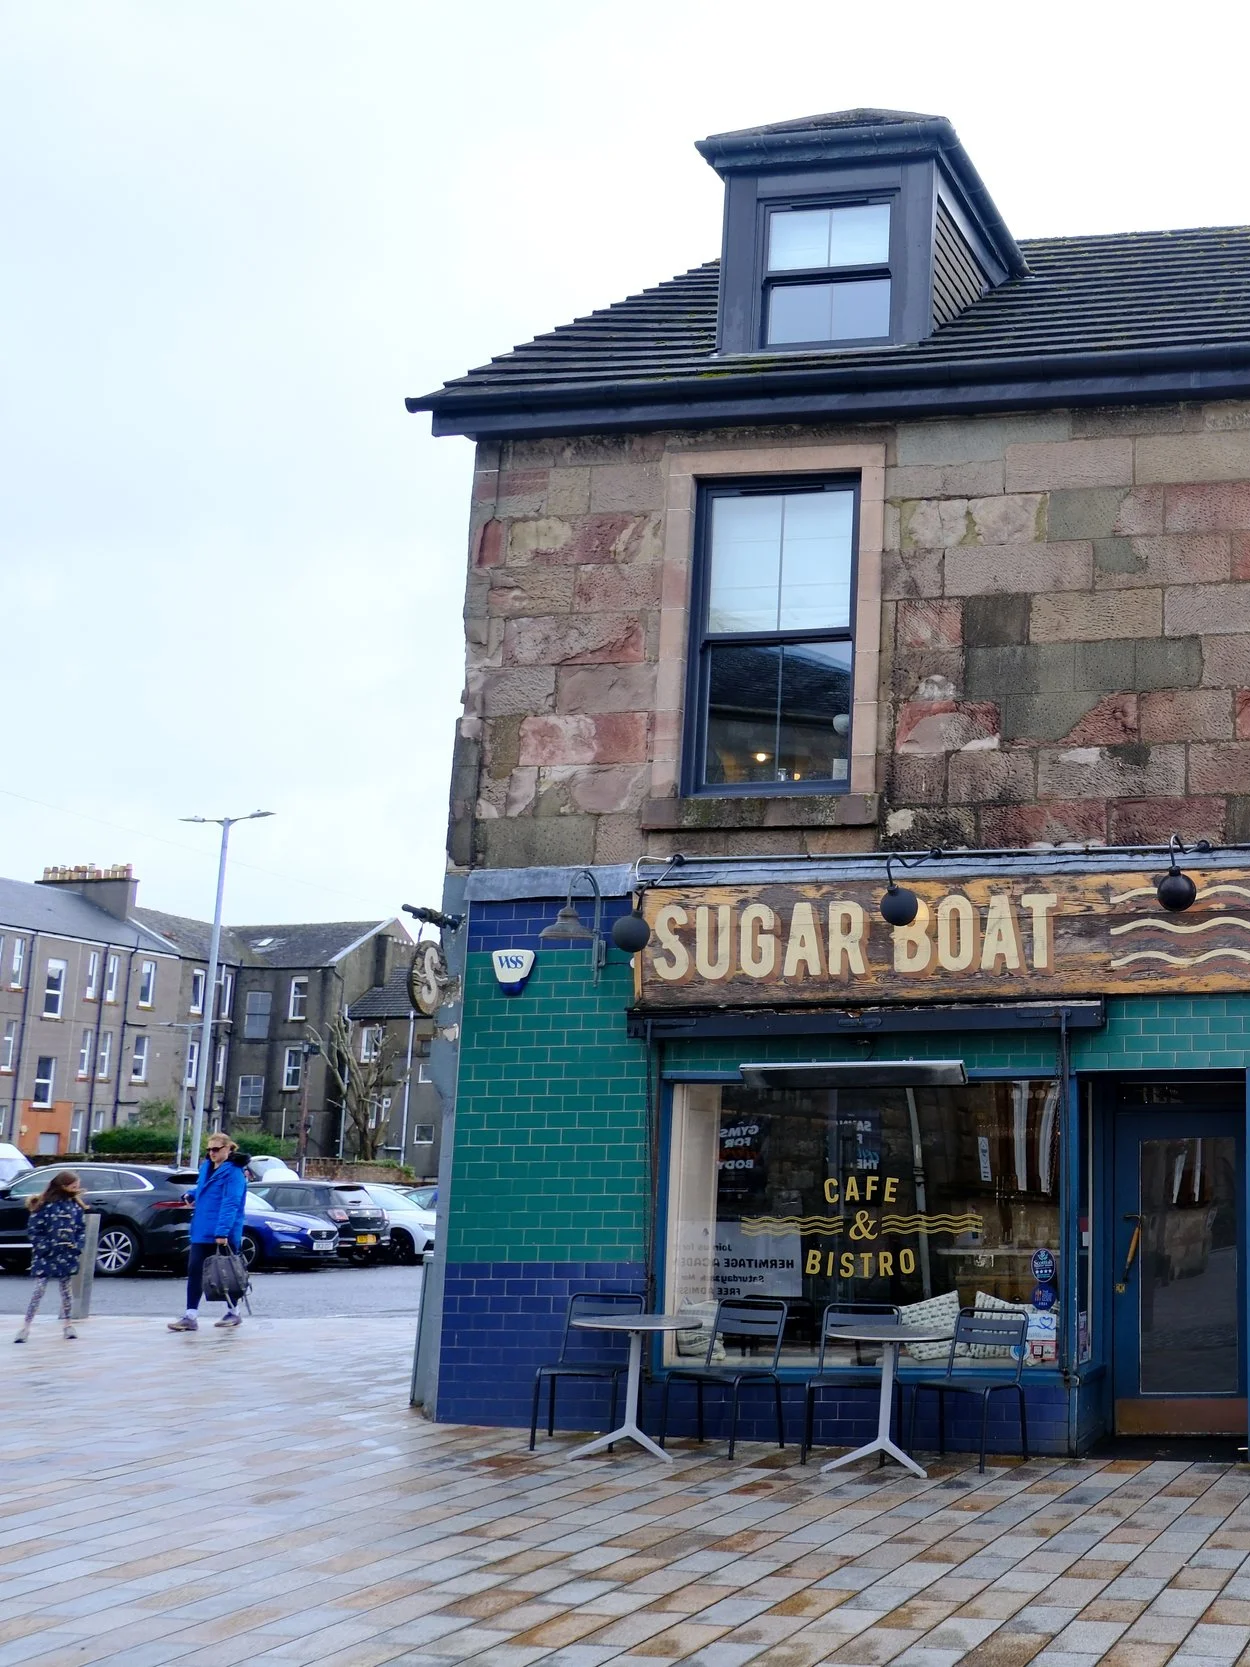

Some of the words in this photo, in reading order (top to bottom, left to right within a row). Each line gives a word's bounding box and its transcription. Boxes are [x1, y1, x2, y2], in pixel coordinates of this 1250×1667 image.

[652, 900, 868, 982] SUGAR
[892, 893, 1058, 976] BOAT
[823, 1175, 899, 1204] CAFE
[848, 1209, 878, 1240] &
[805, 1247, 917, 1278] BISTRO
